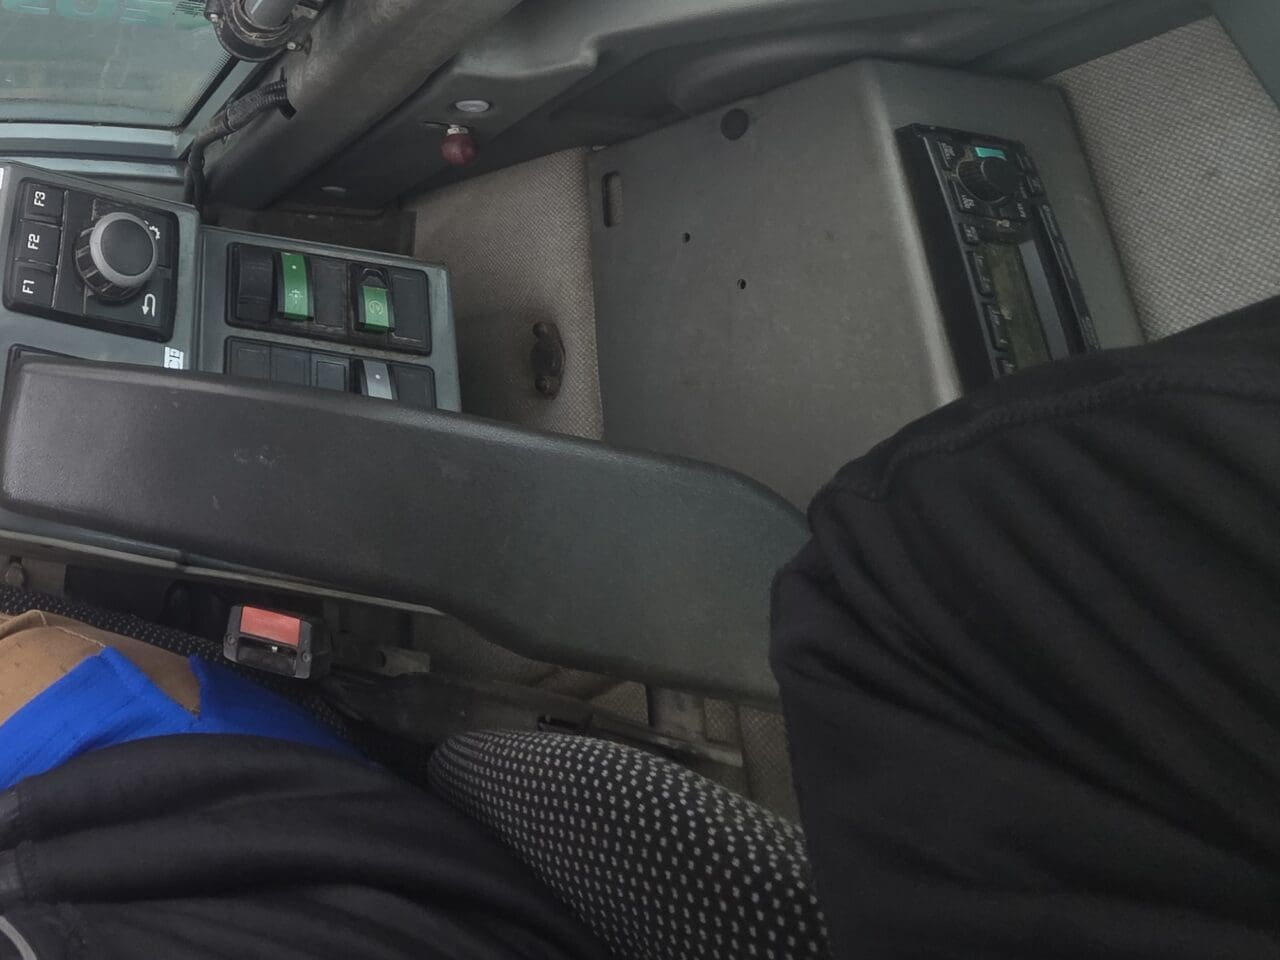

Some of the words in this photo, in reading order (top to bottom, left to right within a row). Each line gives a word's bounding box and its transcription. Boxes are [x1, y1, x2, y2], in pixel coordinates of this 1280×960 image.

[33, 190, 46, 207] F3
[27, 233, 40, 250] F2
[22, 279, 35, 294] F1
